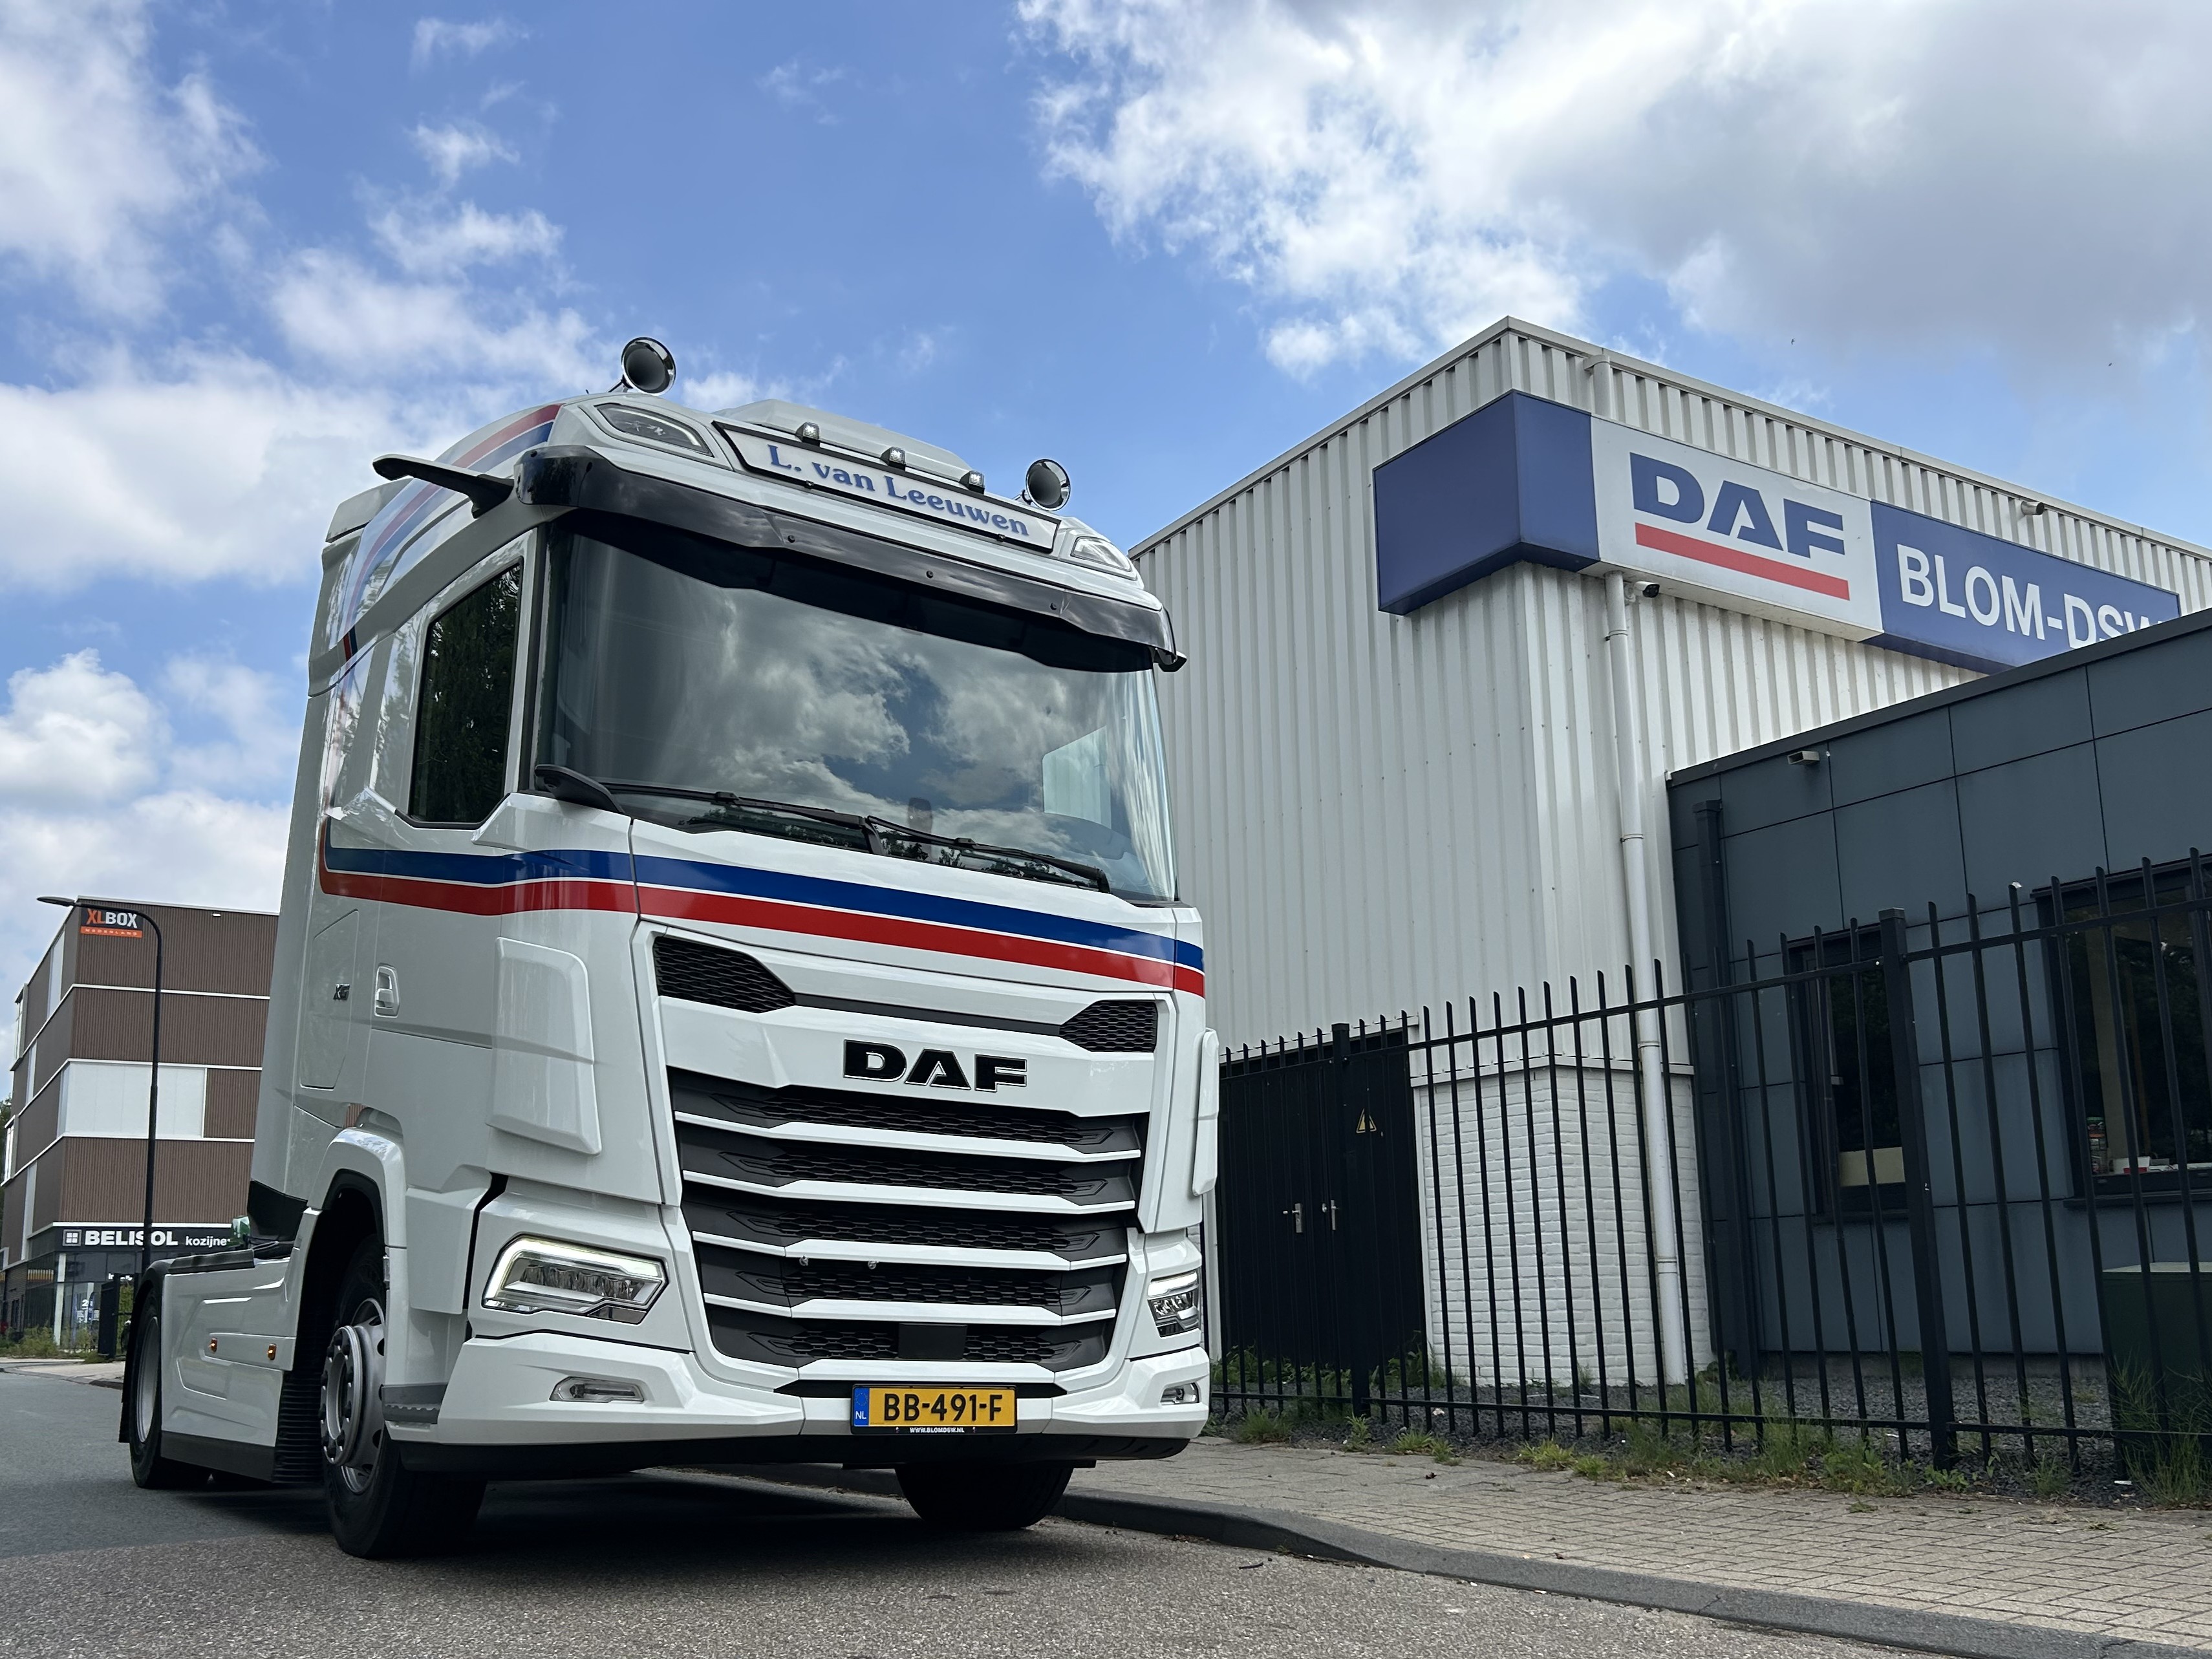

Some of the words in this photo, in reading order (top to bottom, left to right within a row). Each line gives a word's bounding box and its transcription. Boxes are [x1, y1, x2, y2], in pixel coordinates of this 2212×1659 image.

[768, 444, 802, 472] L.
[812, 462, 876, 491] van
[884, 475, 1030, 536] Leeuwen
[1629, 452, 1846, 559] DAF
[1896, 543, 2164, 649] BLOM-DS
[843, 1038, 1027, 1093] DAF
[85, 1230, 178, 1246] BELISOL
[185, 1236, 231, 1248] kozijne
[855, 1410, 866, 1420] NL
[884, 1393, 1003, 1422] BB-491-F
